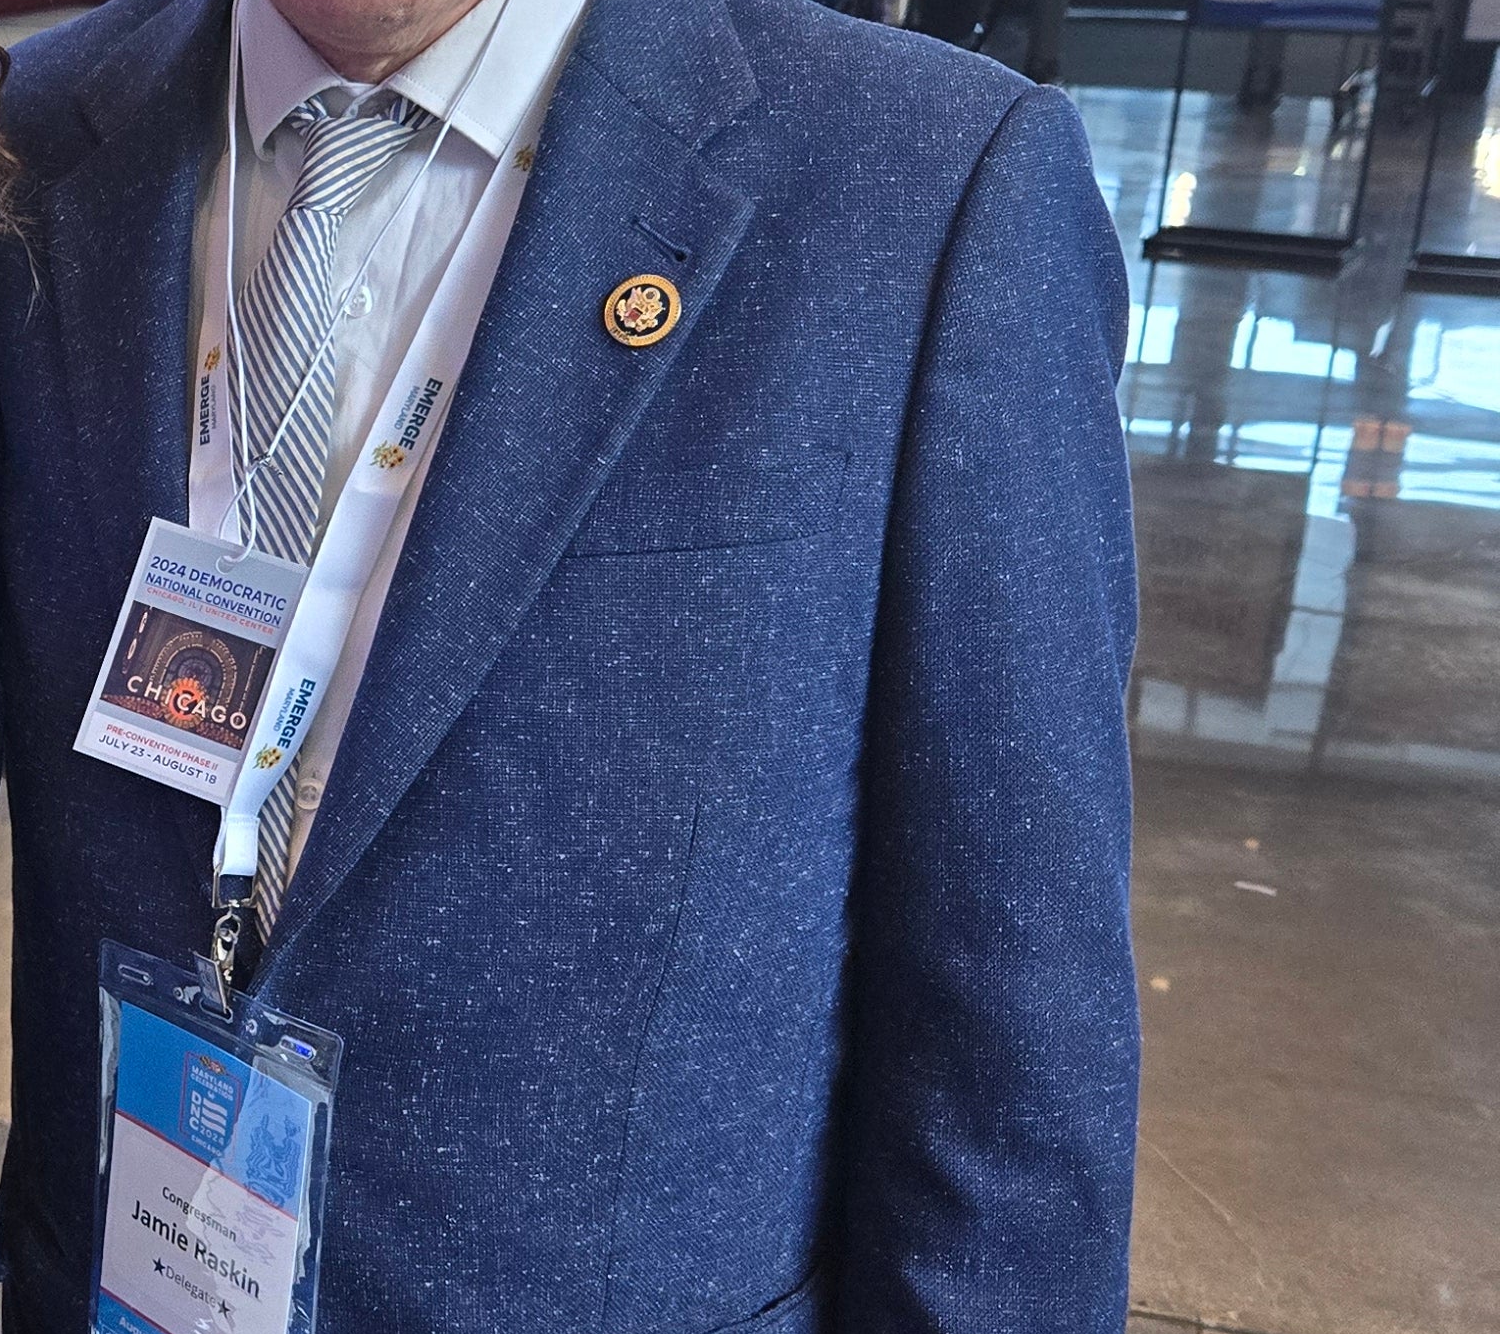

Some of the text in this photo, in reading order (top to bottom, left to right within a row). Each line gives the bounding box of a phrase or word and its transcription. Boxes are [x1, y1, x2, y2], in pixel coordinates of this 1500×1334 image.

[200, 374, 210, 446] EMERGE
[394, 385, 420, 430] MARYLAND
[399, 377, 443, 451] EMERGE
[146, 572, 282, 626] NATIONAL CONVENTION
[150, 556, 287, 611] 2024 DEMOCRATIC
[147, 587, 186, 605] CHICAGO,
[205, 605, 238, 622] UNITED
[239, 617, 274, 635] CENTER
[127, 675, 247, 730] CHICAGO
[273, 687, 295, 732] MARYLAND
[277, 678, 316, 749] EMERGE
[98, 734, 131, 751] JULY
[130, 745, 144, 758] 23
[152, 754, 204, 779] AUGUST
[205, 772, 217, 785] 18
[106, 723, 181, 758] PRE-CONVENTION
[181, 751, 211, 770] PHASE
[190, 1073, 233, 1102] CELEBRATION
[192, 1065, 234, 1094] MARYLAND
[191, 1134, 222, 1157] CHICAGO
[200, 1126, 225, 1146] 2024
[162, 1186, 237, 1242] Congressman
[131, 1199, 262, 1299] Jamie Raskin
[165, 1265, 218, 1308] Delegate
